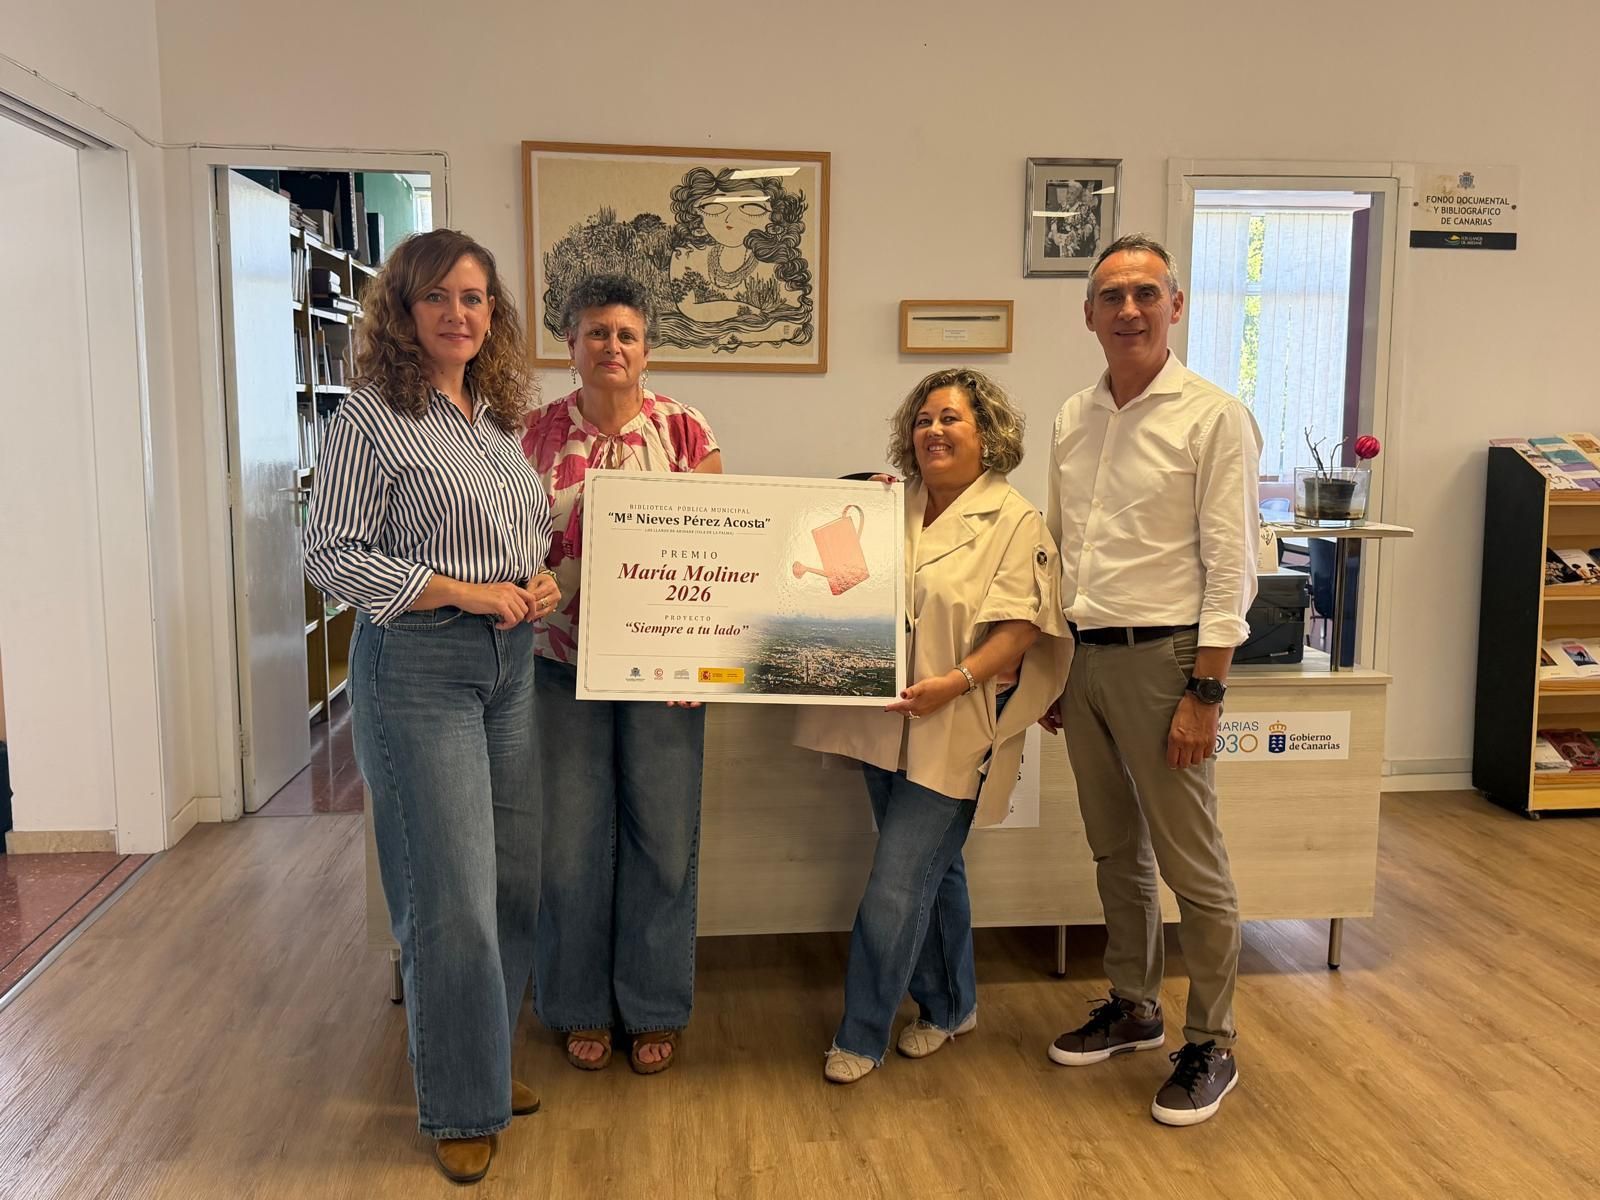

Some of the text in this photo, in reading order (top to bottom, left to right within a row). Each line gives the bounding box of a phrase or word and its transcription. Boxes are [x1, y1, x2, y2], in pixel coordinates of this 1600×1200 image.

[1426, 195, 1510, 206] FONDO DOCUMENTAL
[1433, 206, 1501, 216] Y BIBLIOGRÁFICO
[1441, 217, 1493, 226] DE CANARIAS
[636, 513, 680, 525] Nieves
[683, 514, 721, 527] Pérez
[723, 516, 771, 529] Acosta”
[661, 549, 718, 560] PREMIO
[617, 563, 760, 583] María Moliner
[664, 585, 712, 602] 2026
[664, 614, 712, 622] PROYECTO
[625, 621, 750, 636] “Siempre a tu lado”
[1289, 733, 1332, 742] Gobierno
[1288, 741, 1341, 750] de Canarias
